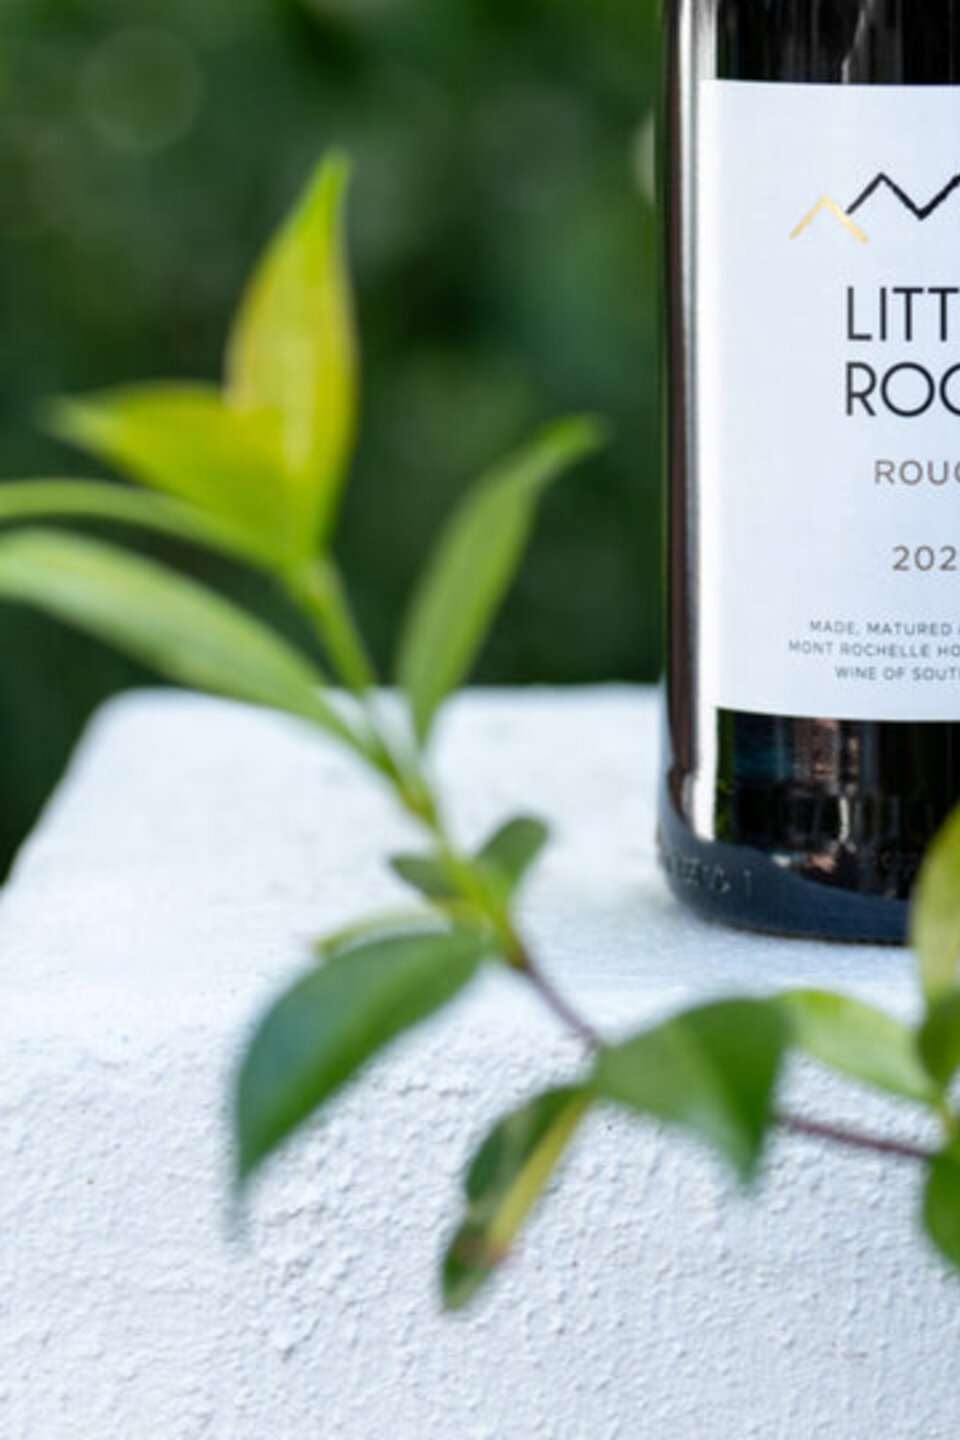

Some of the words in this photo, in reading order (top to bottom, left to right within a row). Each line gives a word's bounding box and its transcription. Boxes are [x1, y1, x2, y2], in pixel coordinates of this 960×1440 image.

[866, 621, 953, 637] MATURED
[788, 639, 834, 655] MONT
[839, 642, 930, 659] ROCHELLE
[834, 665, 878, 681] WINE
[882, 665, 906, 681] OF
